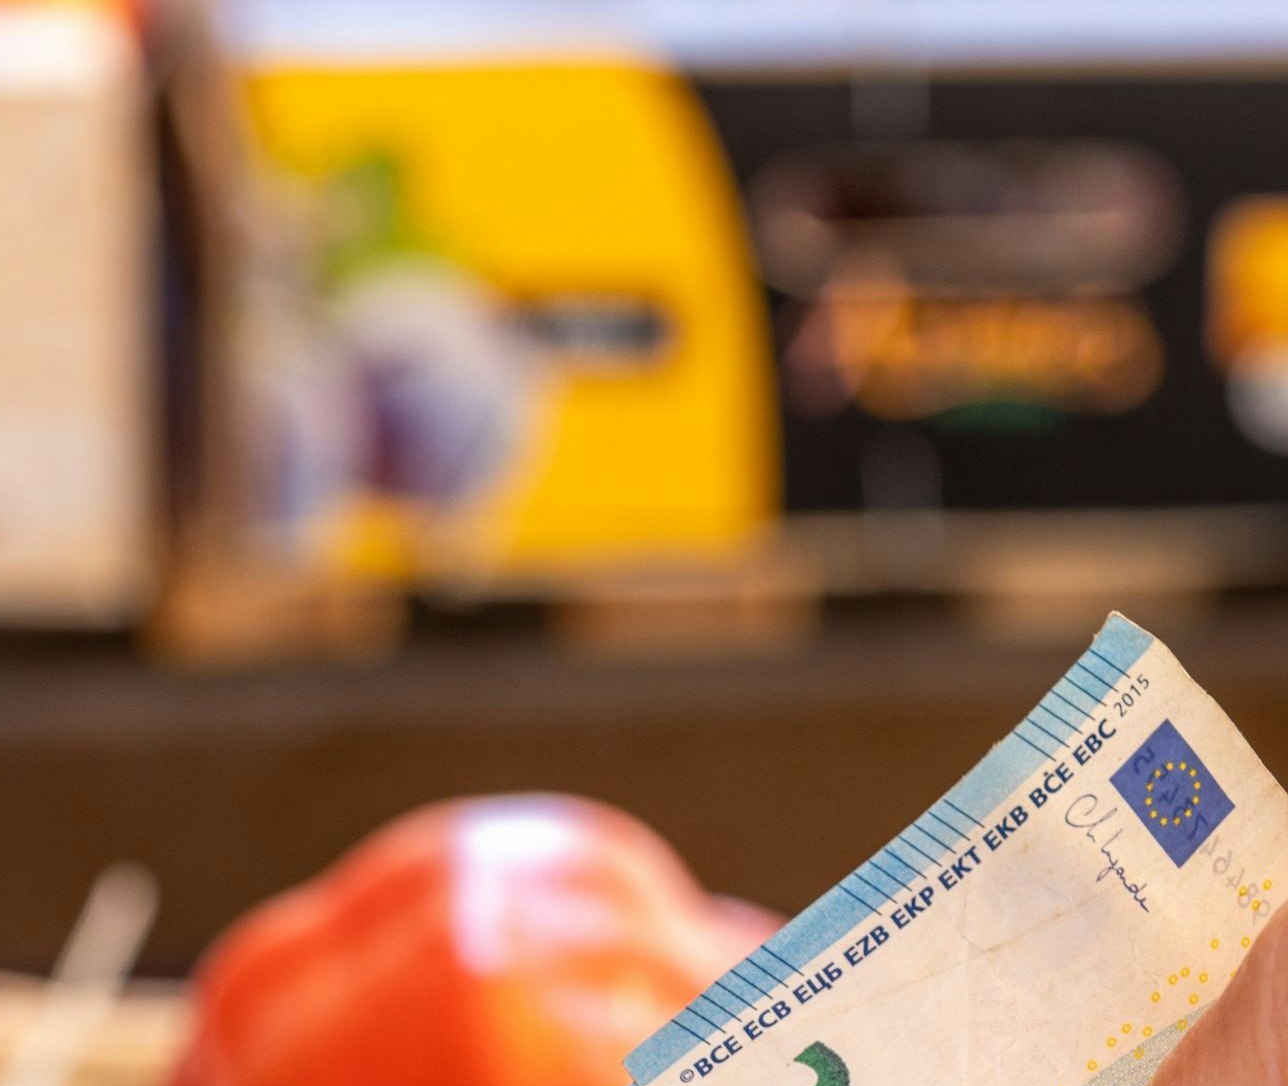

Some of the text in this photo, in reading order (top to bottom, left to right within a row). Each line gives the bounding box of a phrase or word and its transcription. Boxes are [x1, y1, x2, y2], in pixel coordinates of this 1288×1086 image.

[743, 1000, 792, 1041] ECB
[842, 924, 891, 967] EZB
[889, 885, 935, 931] EKP
[981, 804, 1029, 852] EKB
[1071, 718, 1117, 767] EBC
[1113, 673, 1150, 718] 2015
